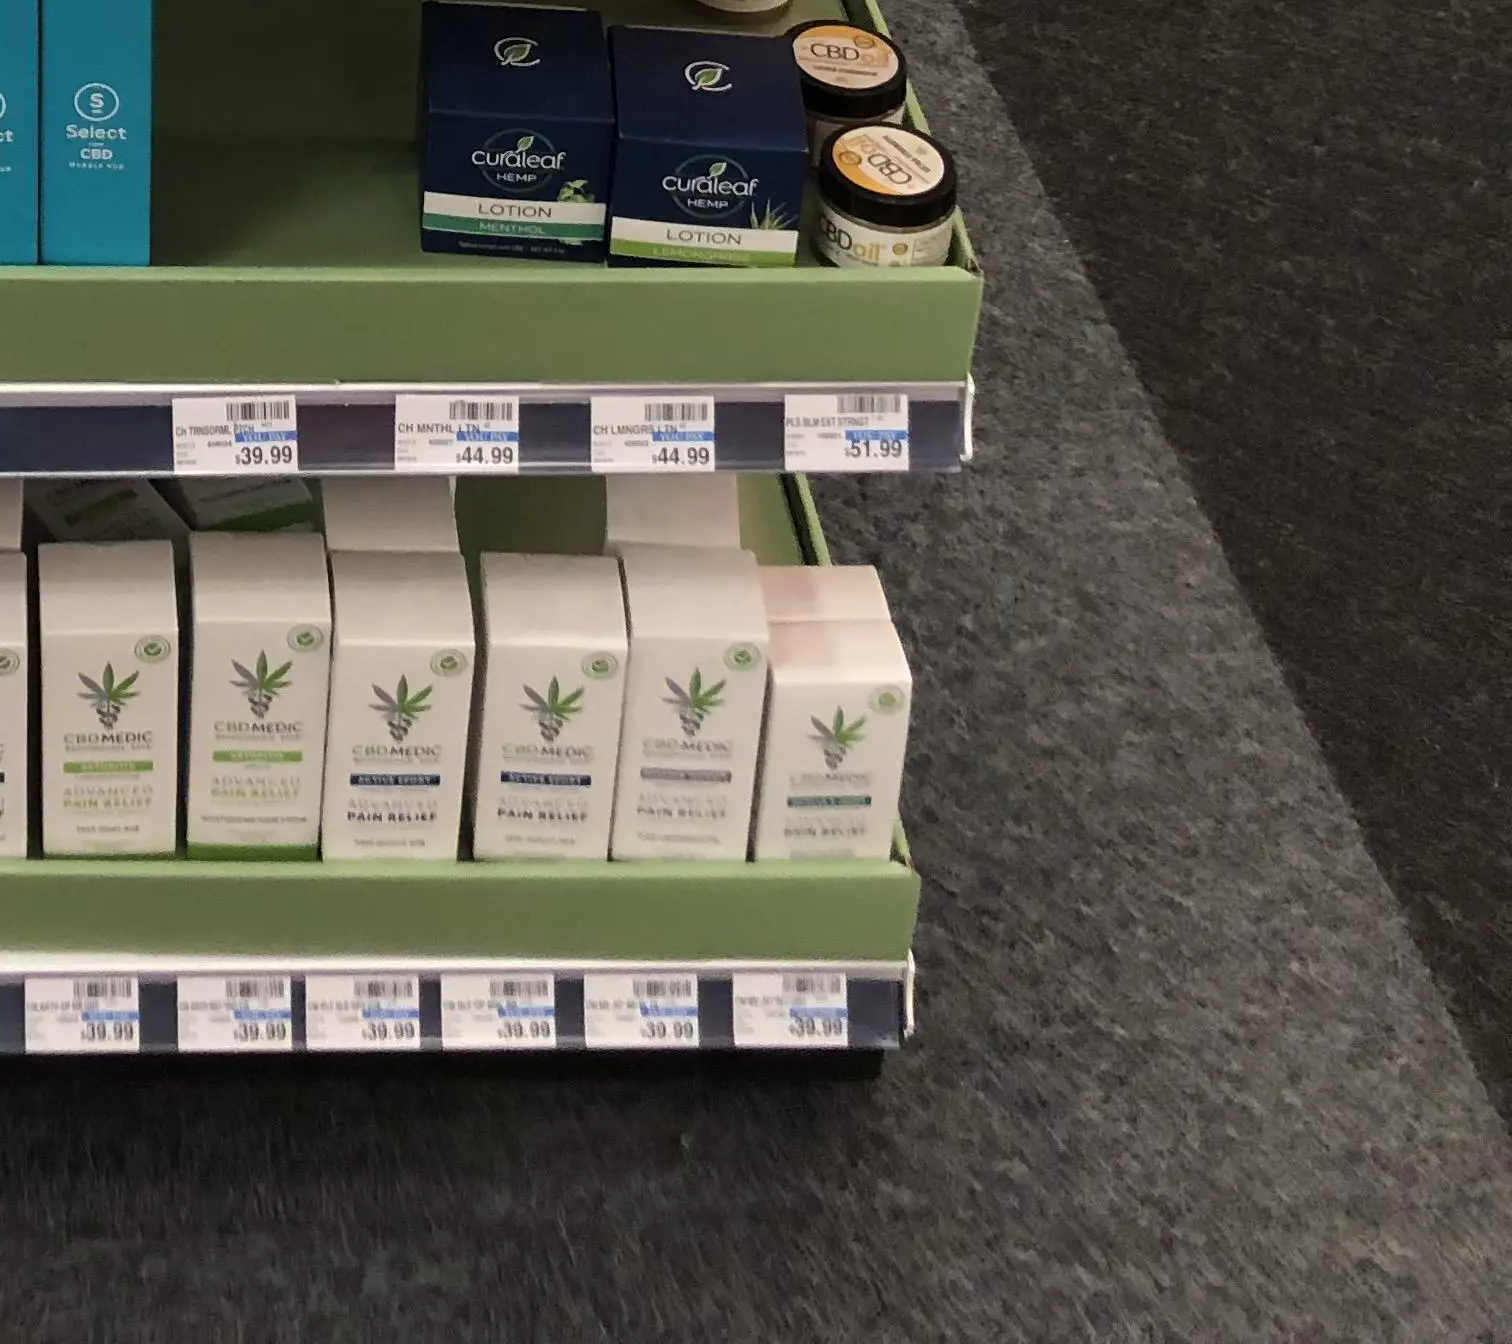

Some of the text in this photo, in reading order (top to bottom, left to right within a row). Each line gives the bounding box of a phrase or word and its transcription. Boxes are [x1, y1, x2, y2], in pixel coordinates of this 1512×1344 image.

[810, 42, 860, 61] CBD
[65, 124, 128, 140] Select
[80, 148, 113, 160] CBD
[471, 146, 567, 170] curaleaf
[496, 173, 537, 182] HEMP
[662, 172, 760, 197] curaleaf
[478, 203, 551, 218] LOTION
[688, 199, 728, 208] HEMP
[666, 229, 742, 244] LOTION
[235, 446, 292, 465] $39.99
[456, 446, 513, 464] $44.99
[652, 447, 710, 465] $44.99
[844, 439, 902, 458] $51.99
[214, 721, 303, 734] CBDMEDIC
[64, 731, 152, 745] CBDMEDIC
[347, 812, 437, 822] PAIN RELIEF
